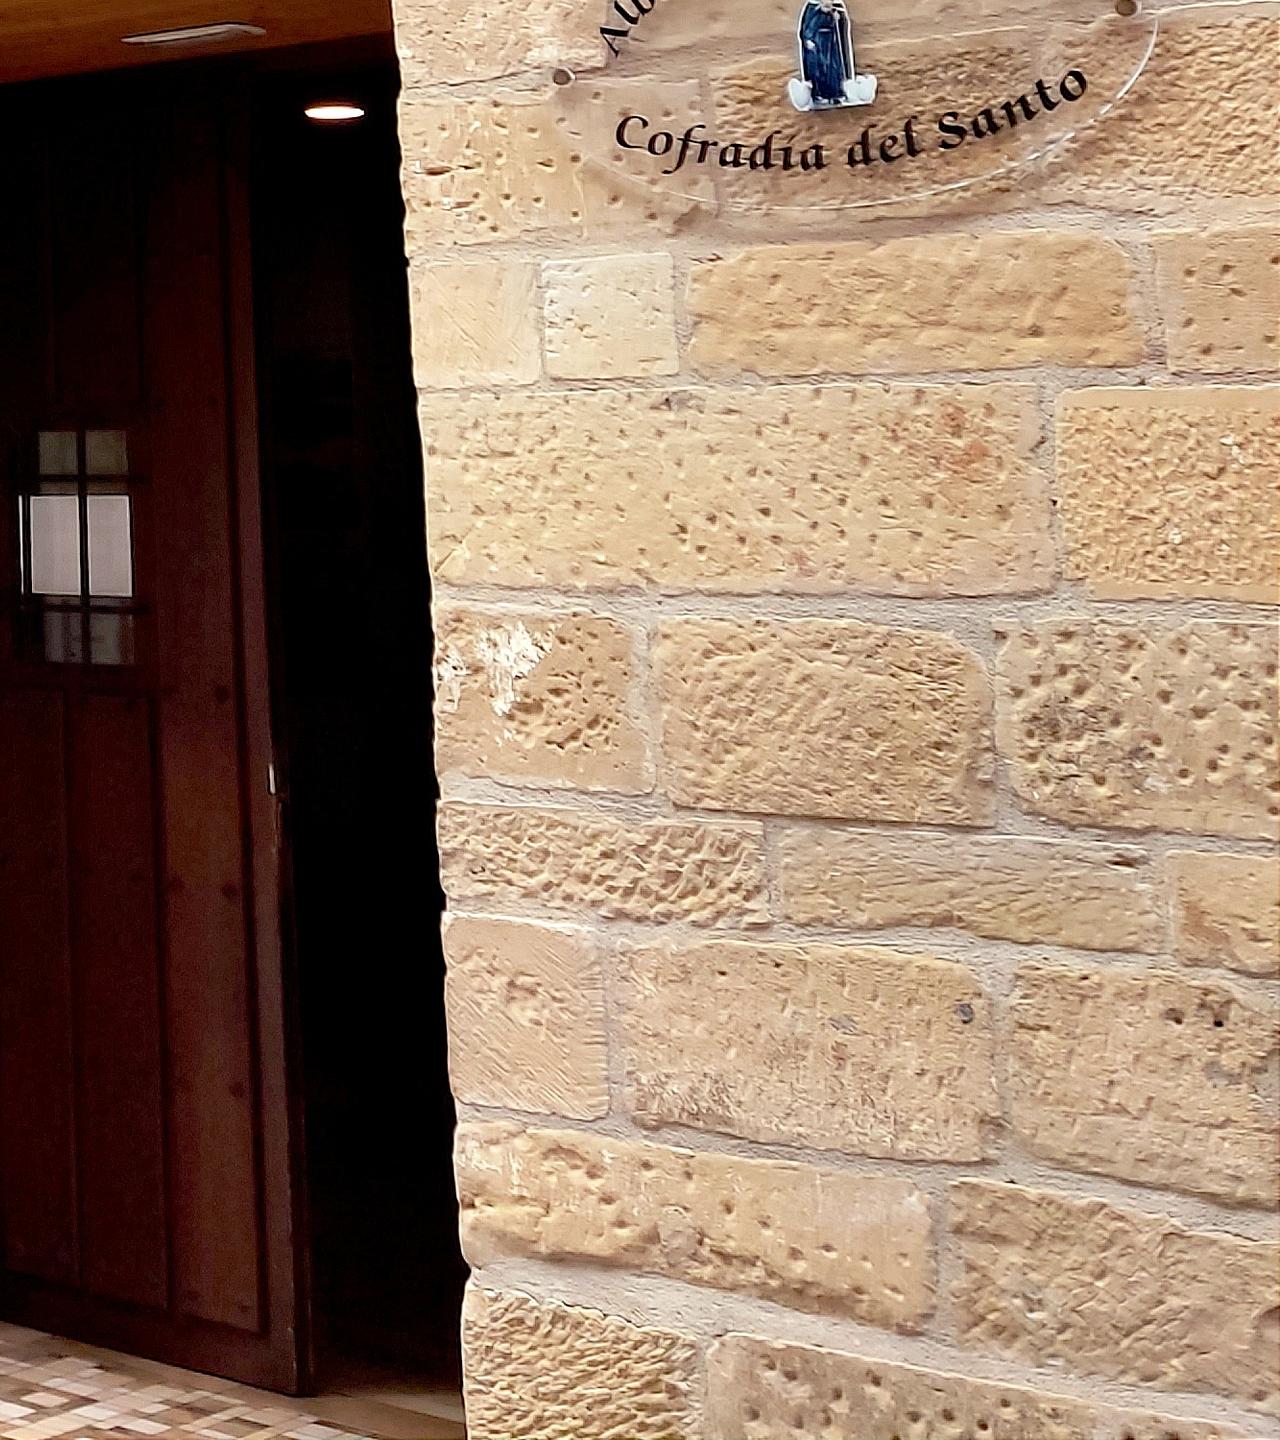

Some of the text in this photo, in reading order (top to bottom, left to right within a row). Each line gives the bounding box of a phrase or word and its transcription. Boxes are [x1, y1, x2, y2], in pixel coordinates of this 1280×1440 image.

[616, 68, 1088, 174] Cofradía del Santo
